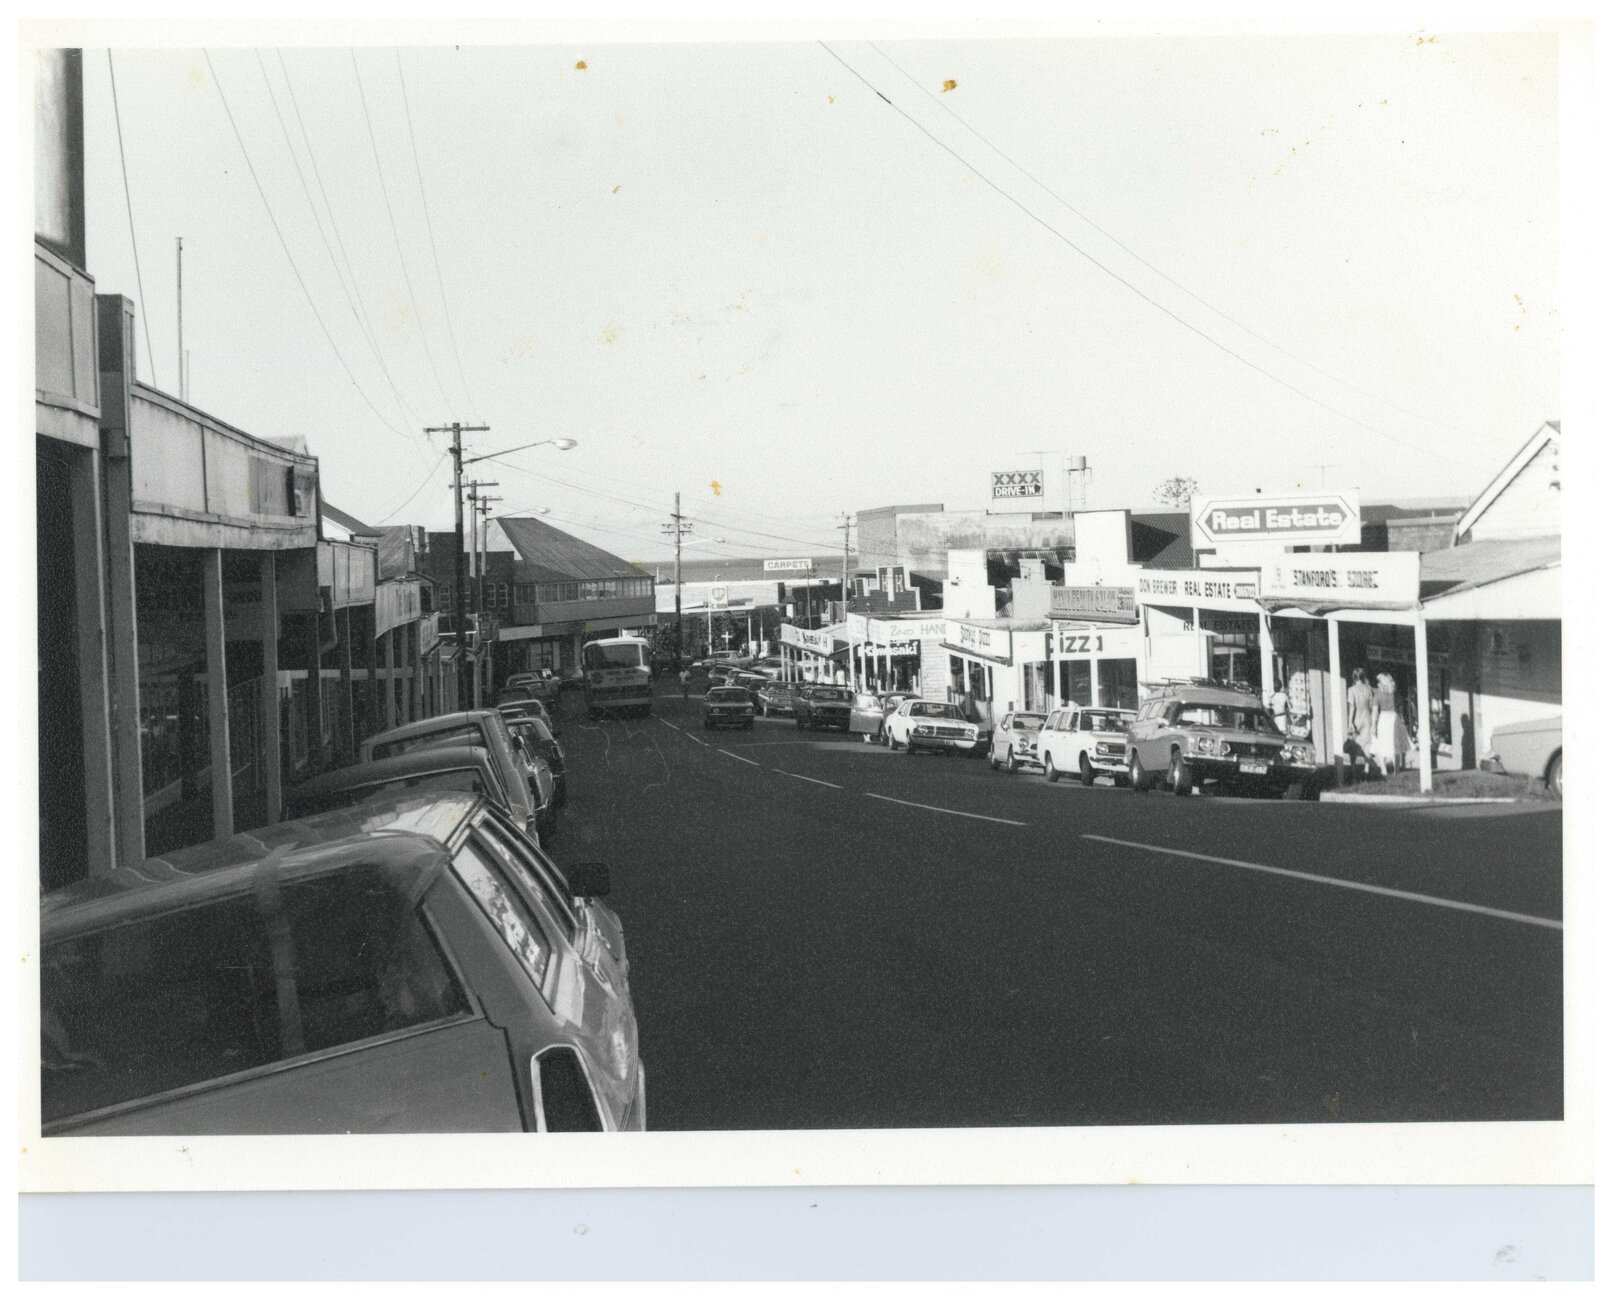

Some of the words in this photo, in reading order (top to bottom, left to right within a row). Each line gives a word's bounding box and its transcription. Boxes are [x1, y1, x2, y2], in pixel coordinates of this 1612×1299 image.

[994, 472, 1040, 486] XXXX
[995, 486, 1035, 497] DRIVE-IN
[1211, 510, 1260, 530] Real
[1265, 507, 1342, 528] Estate
[767, 561, 809, 569] CARPETS
[1140, 578, 1151, 593] DON
[1184, 581, 1201, 597] REAL
[1205, 582, 1231, 599] ESTATE
